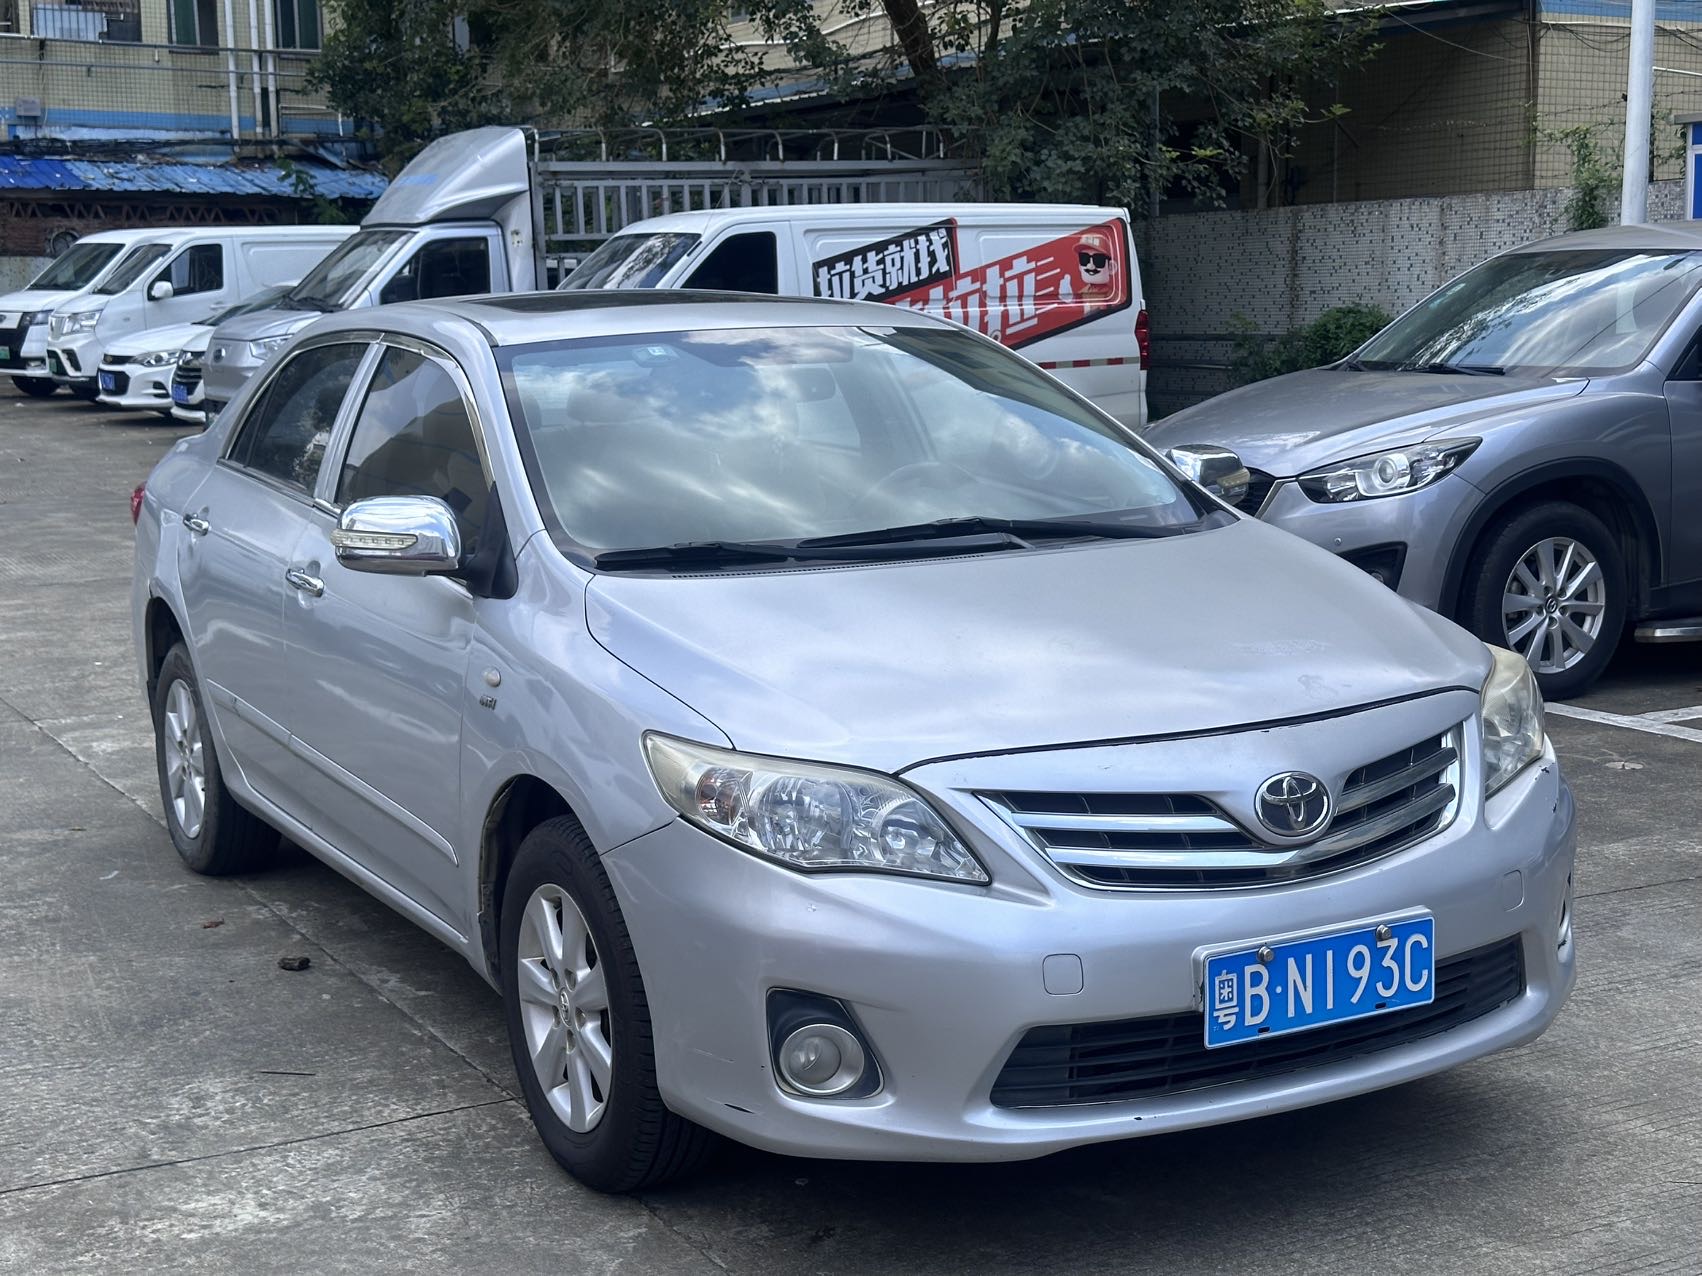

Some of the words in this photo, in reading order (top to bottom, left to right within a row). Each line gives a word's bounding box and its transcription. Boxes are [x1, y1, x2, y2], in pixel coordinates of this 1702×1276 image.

[817, 228, 949, 300] 拉货就找
[895, 255, 1038, 341] 拉拉
